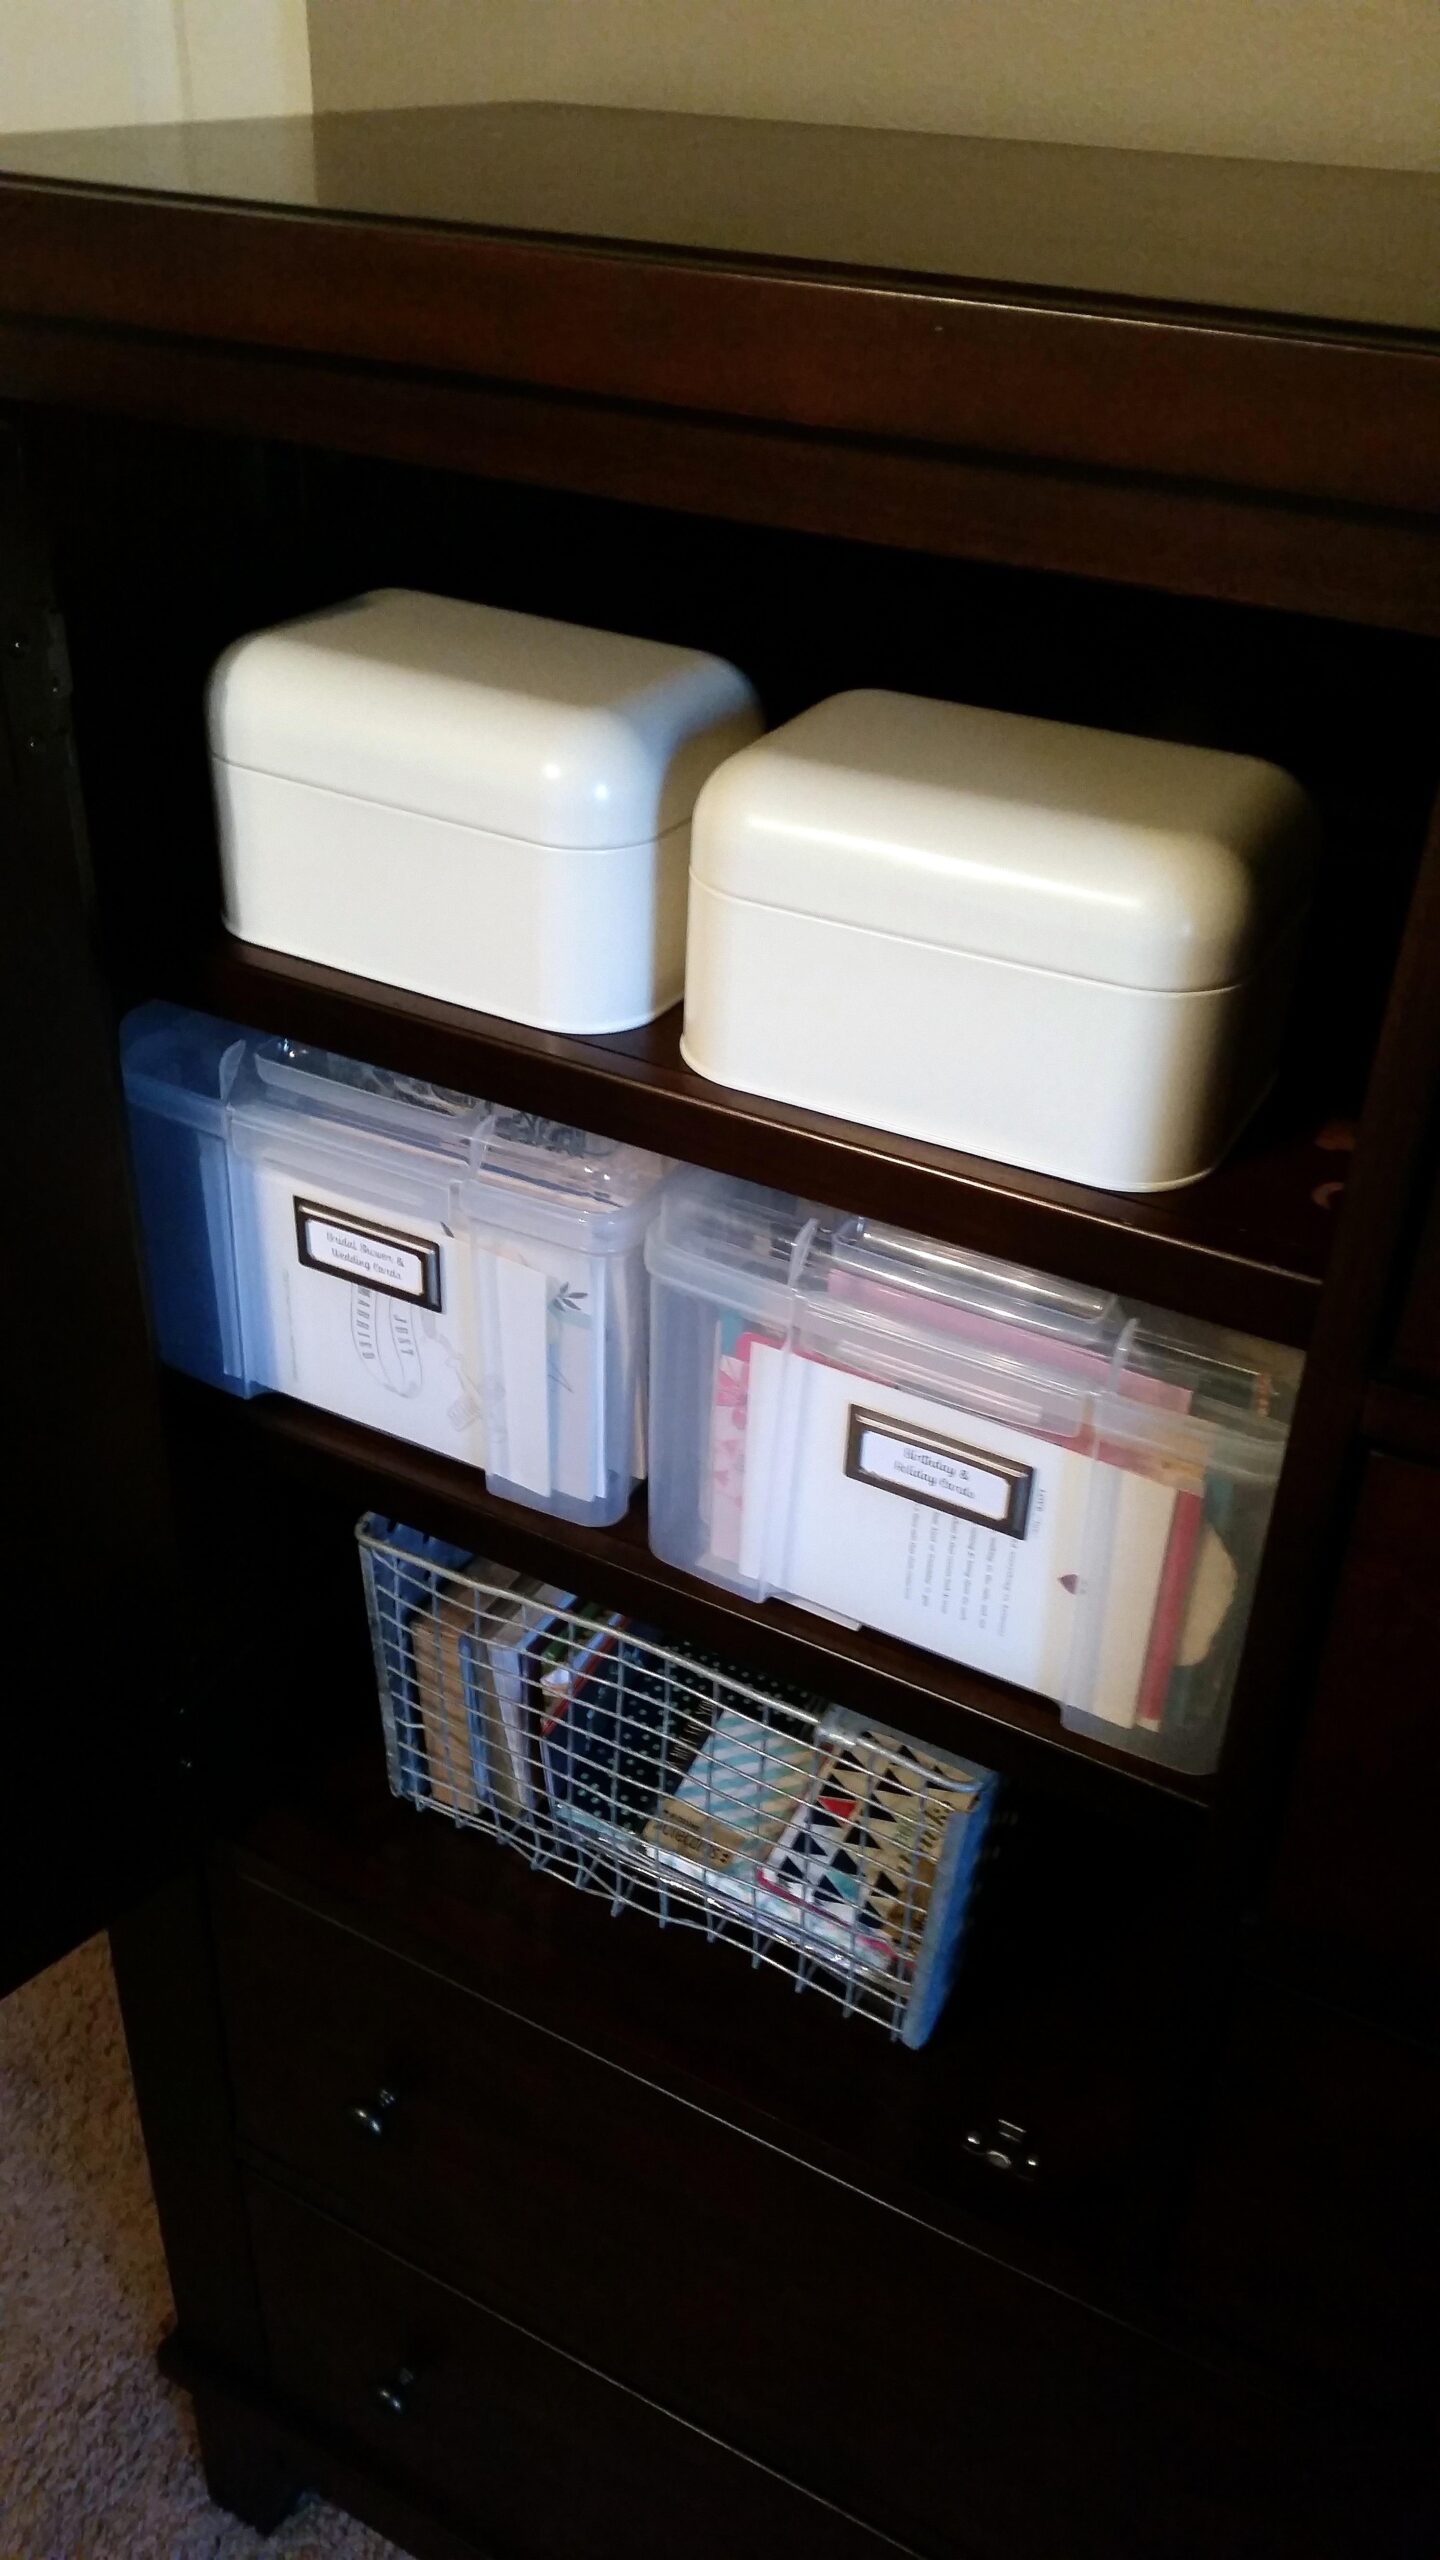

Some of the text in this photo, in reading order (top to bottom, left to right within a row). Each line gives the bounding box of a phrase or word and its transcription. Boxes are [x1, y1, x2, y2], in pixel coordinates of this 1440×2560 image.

[331, 1247, 402, 1280] Wedding Cards
[396, 1257, 405, 1268] &
[893, 1459, 977, 1499] Holiday Cards
[903, 1447, 969, 1481] Birthday &
